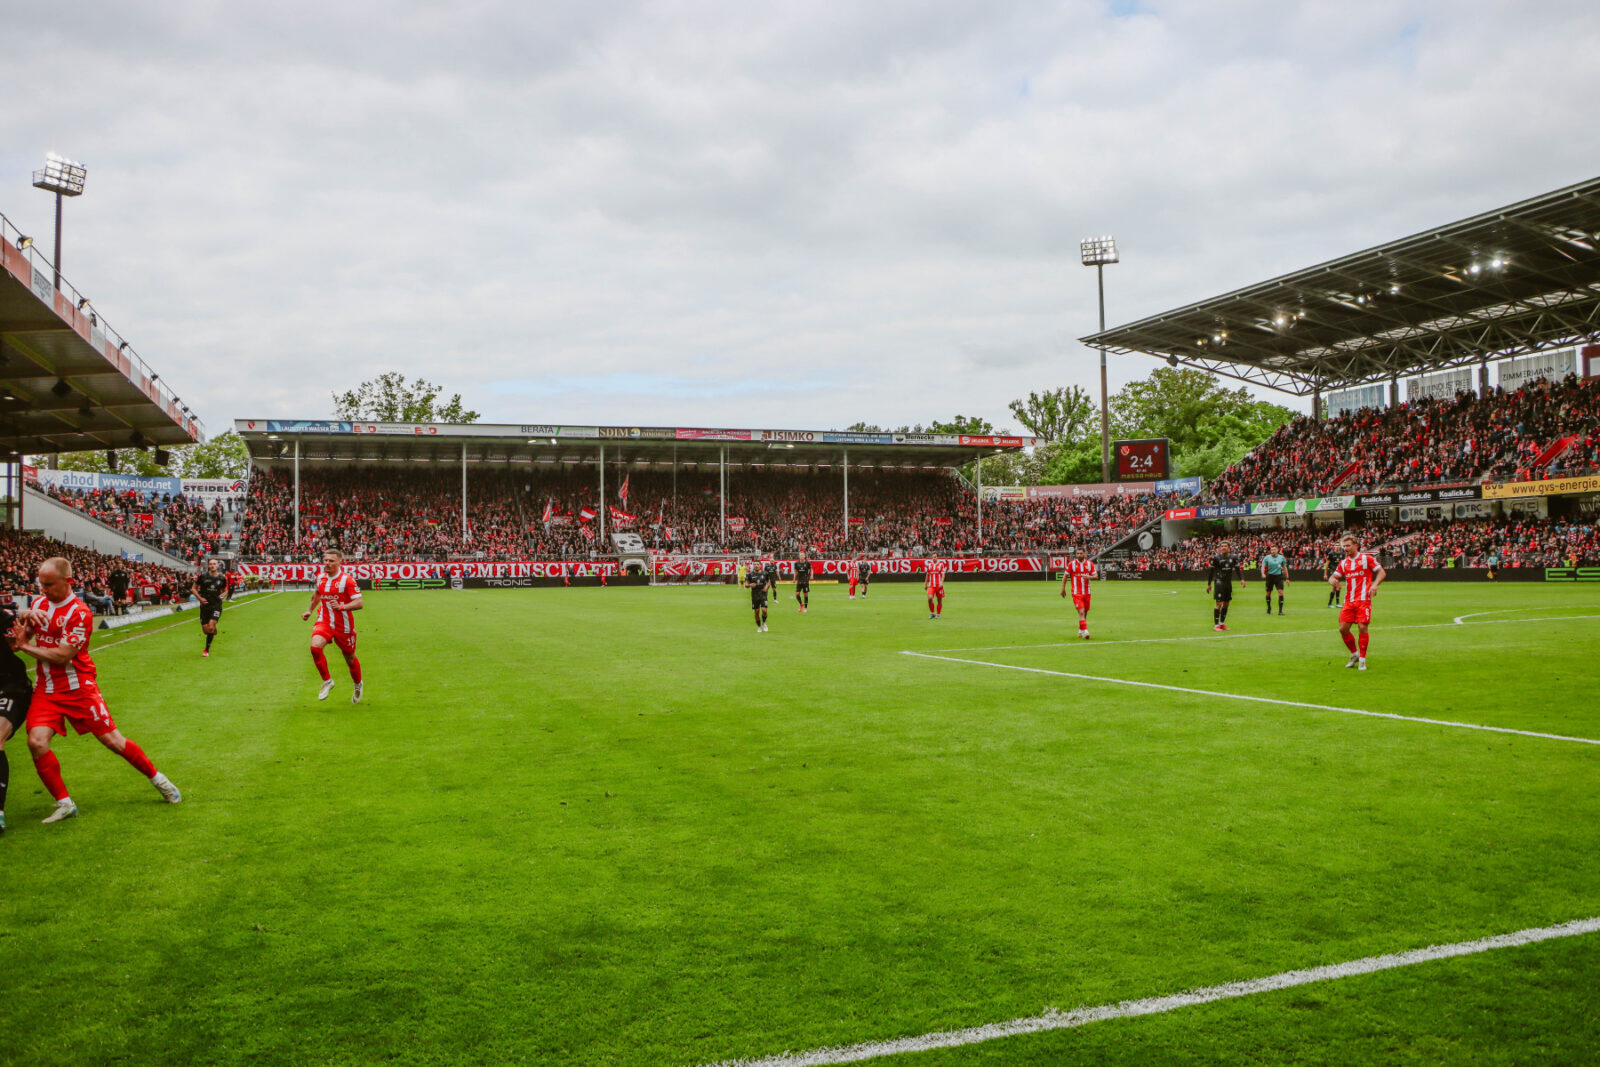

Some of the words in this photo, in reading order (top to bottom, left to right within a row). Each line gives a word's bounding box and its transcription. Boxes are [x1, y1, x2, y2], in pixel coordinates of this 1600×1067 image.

[1502, 366, 1555, 382] ZIMMERMANN
[521, 425, 554, 433] BERATA
[600, 428, 629, 437] SDIM
[774, 431, 814, 441] ISIMKO
[1130, 454, 1154, 468] 2:4
[62, 472, 95, 487] ahod
[102, 477, 172, 490] www.ahod.net
[183, 485, 230, 493] STEIDEL
[1439, 488, 1475, 498] Koalick.de
[1200, 506, 1219, 517] Voller
[1220, 503, 1247, 515] Einsatz!
[1408, 507, 1424, 517] TRC
[1465, 503, 1483, 512] TRC
[979, 558, 1019, 573] 1966
[371, 579, 447, 590] ESP
[485, 579, 532, 587] TRONIC
[90, 702, 108, 721] 14
